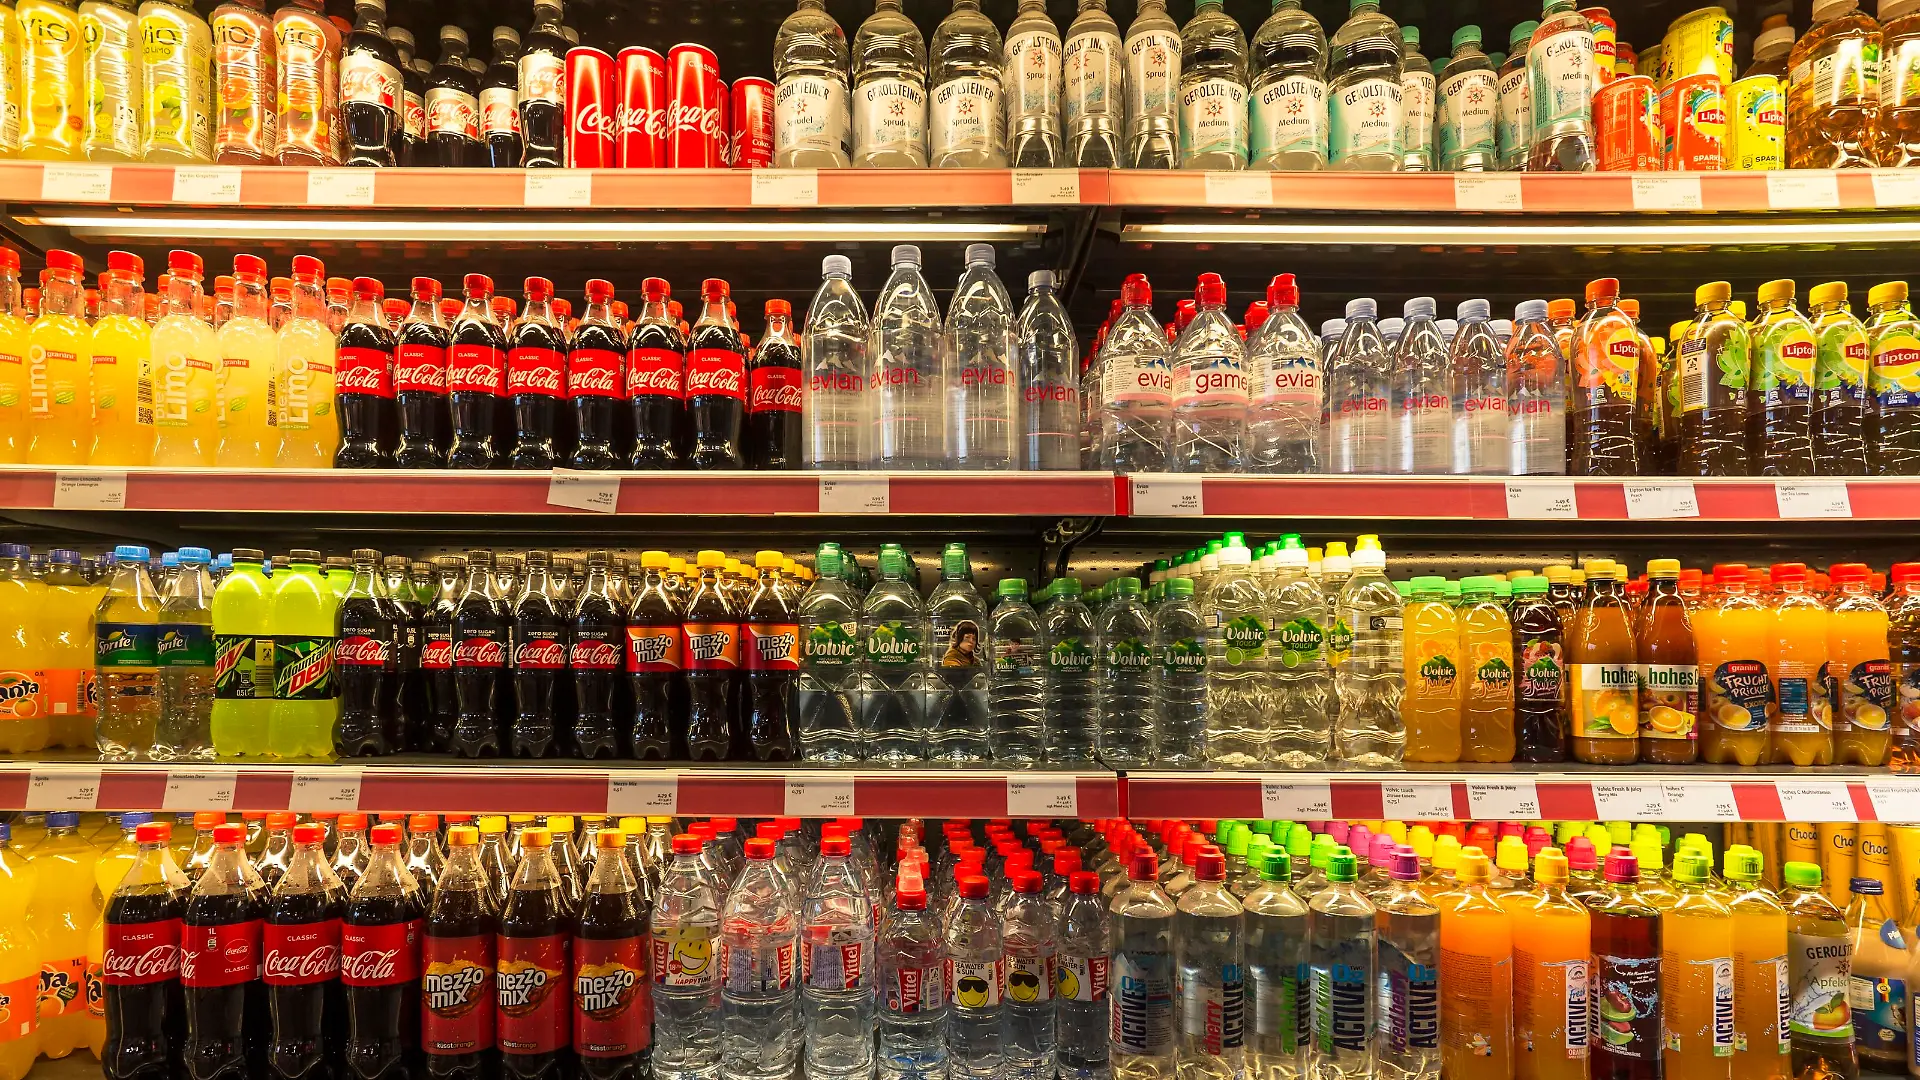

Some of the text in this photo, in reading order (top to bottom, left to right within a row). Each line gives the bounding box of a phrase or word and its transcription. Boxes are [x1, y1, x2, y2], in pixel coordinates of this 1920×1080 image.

[1878, 351, 1919, 364] Lipton
[446, 363, 501, 388] Coca-Cola
[508, 366, 562, 390] Coca-Cola
[628, 367, 681, 391] Coca-Cola
[687, 367, 743, 391] Coca-Cola
[809, 370, 863, 392] evian
[870, 367, 921, 390] evian
[962, 365, 1016, 387] evian
[1196, 373, 1248, 393] game
[1276, 371, 1321, 388] evian
[1024, 382, 1076, 402] evian
[1342, 396, 1388, 413] evian
[1403, 394, 1449, 410] evian
[158, 635, 184, 653] Sprite
[633, 635, 673, 651] mezzo
[690, 631, 730, 648] mezzo
[757, 632, 796, 649] mezzo
[1226, 627, 1264, 642] Volvic
[1282, 630, 1320, 643] Volvic
[97, 635, 131, 654] Sprite
[335, 640, 393, 661] Coca-Cola
[453, 641, 508, 664] Coca-Cola
[514, 640, 568, 664] Coca-Cola
[570, 640, 624, 664] Coca-Cola
[693, 643, 724, 660] mix
[762, 644, 792, 660] mix
[805, 640, 855, 656] Volvic
[869, 637, 918, 654] Volvic
[636, 646, 667, 664] mix
[1051, 651, 1093, 666] Volvic
[1110, 651, 1150, 666] Volvic
[1165, 651, 1205, 666] Volvic
[1423, 666, 1454, 677] Volvic
[1481, 668, 1511, 680] Volvic
[1529, 666, 1560, 678] Volvic
[1601, 666, 1637, 684] hohes
[1648, 667, 1693, 685] hohes
[1731, 664, 1758, 672] granini
[122, 933, 154, 941] CLASSIC
[208, 927, 217, 935] 1L
[287, 933, 318, 942] CLASSIC
[71, 959, 82, 967] 1L
[224, 964, 250, 973] CLASSIC
[655, 940, 668, 979] Vittel
[780, 945, 793, 985] Vittel
[844, 945, 861, 984] Vittel
[1017, 957, 1036, 965] WATER
[426, 967, 484, 992] mezzo
[578, 969, 636, 994] mezzo
[1093, 957, 1107, 997] Vittel
[431, 982, 471, 1010] mix
[500, 985, 534, 1006] mix
[902, 969, 919, 1008] Vittel
[583, 986, 624, 1011] mix
[1122, 991, 1147, 1050] ACTIVE
[1223, 982, 1244, 1049] ACTIVE
[1333, 981, 1365, 1052] ACTIVE
[1409, 981, 1437, 1050] ACTIVE
[1568, 999, 1587, 1047] ACTIVE
[1715, 995, 1734, 1045] ACTIVE
[1203, 1000, 1223, 1056] cherry
